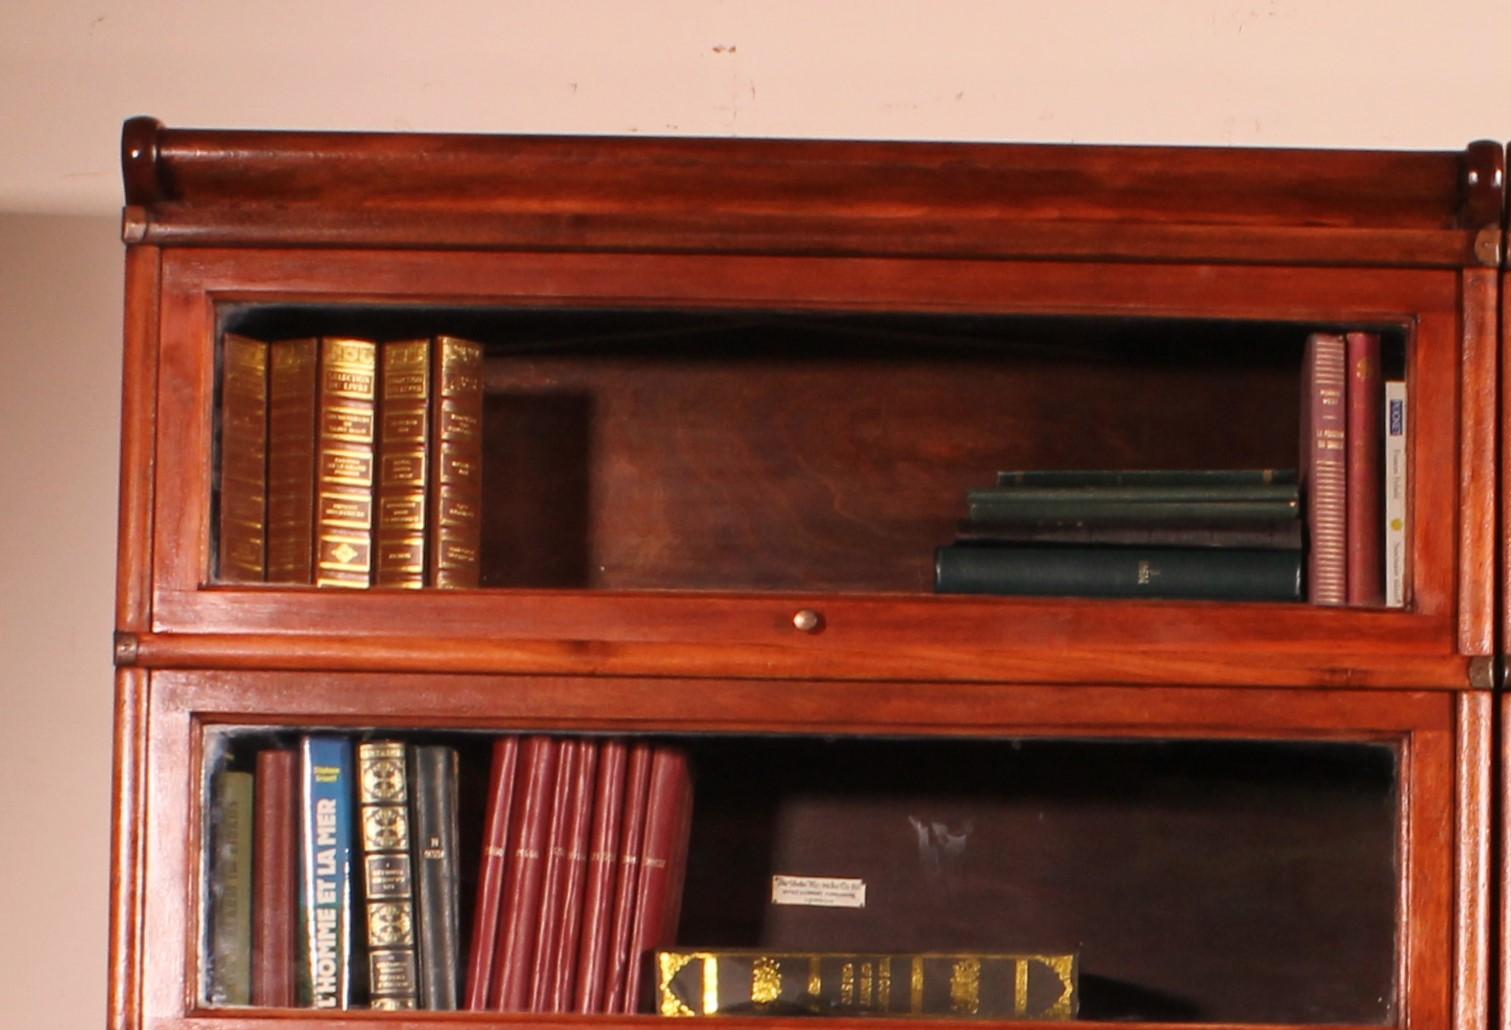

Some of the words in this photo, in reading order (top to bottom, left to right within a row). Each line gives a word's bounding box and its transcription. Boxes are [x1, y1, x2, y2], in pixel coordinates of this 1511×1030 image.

[316, 799, 337, 846] MER
[316, 849, 336, 876] LA
[316, 878, 336, 904] ET
[316, 908, 337, 1008] L'HOMME
